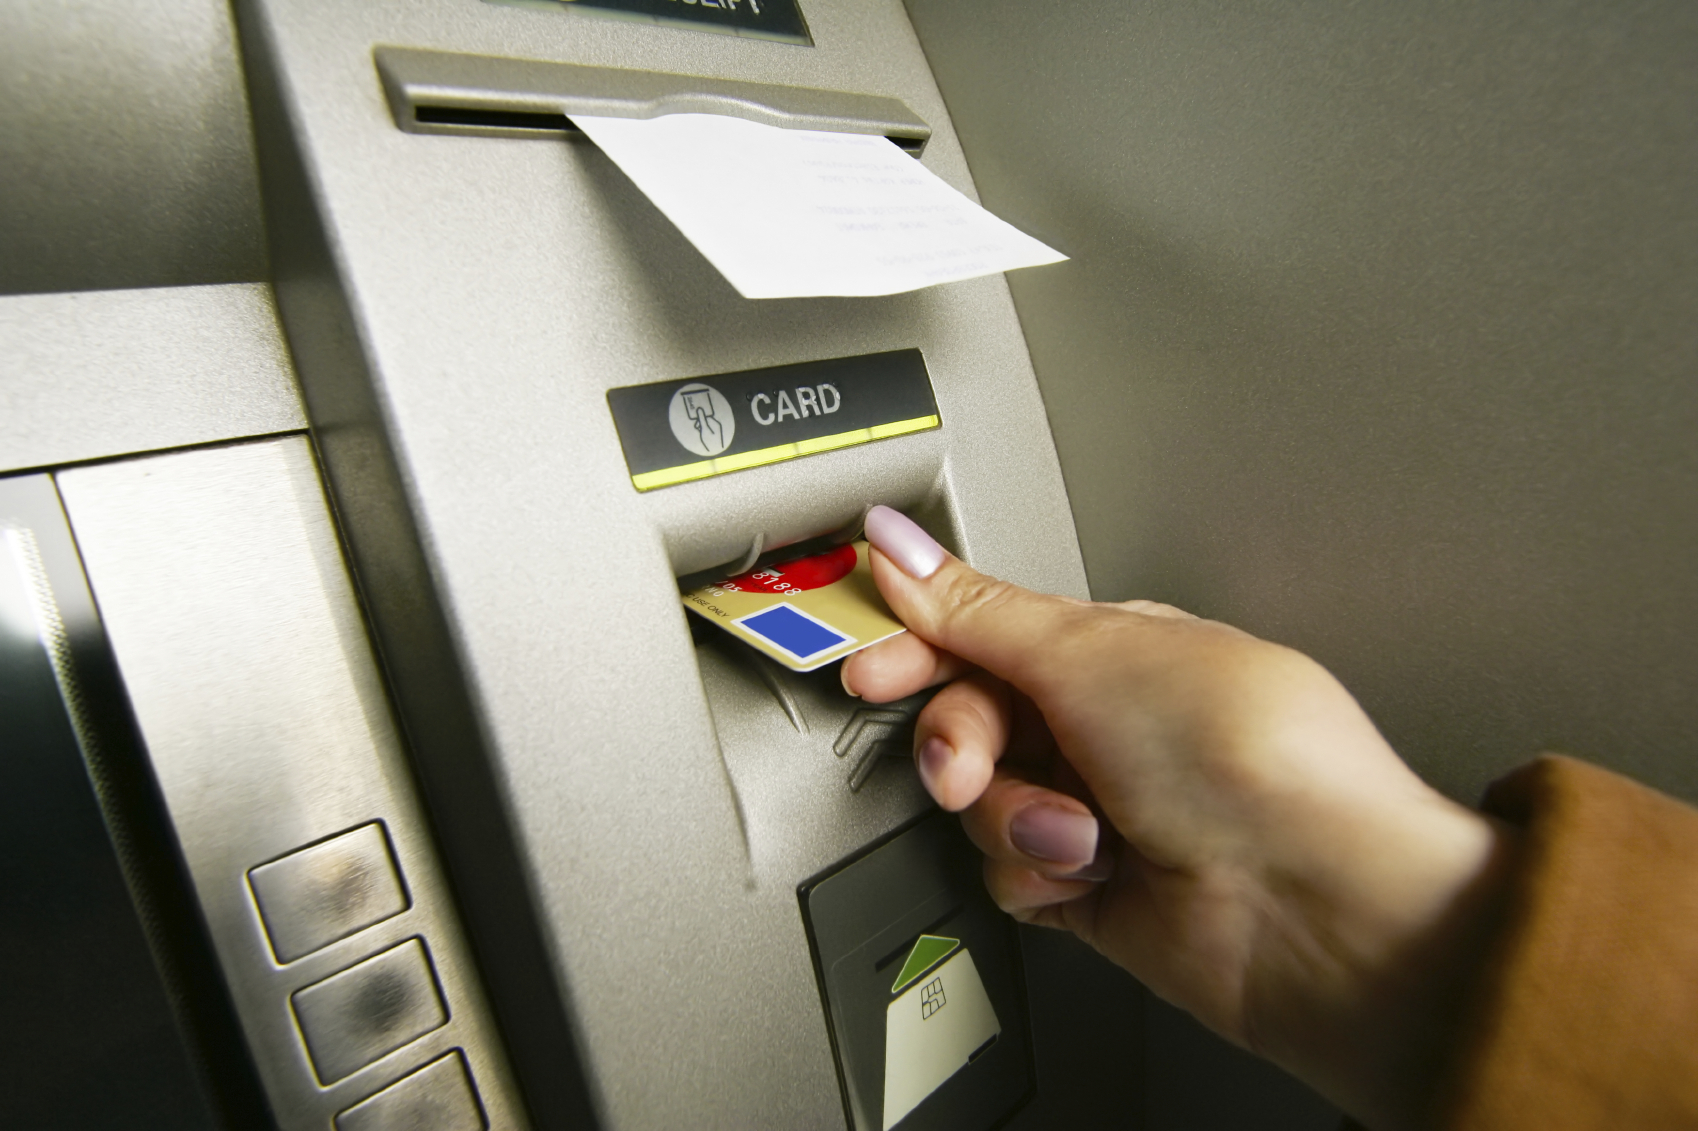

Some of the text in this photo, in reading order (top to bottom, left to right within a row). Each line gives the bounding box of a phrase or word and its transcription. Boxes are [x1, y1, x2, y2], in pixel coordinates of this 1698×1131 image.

[751, 383, 841, 426] CARD
[752, 571, 802, 596] 8188
[692, 596, 710, 607] USE
[707, 605, 730, 618] ONLY
